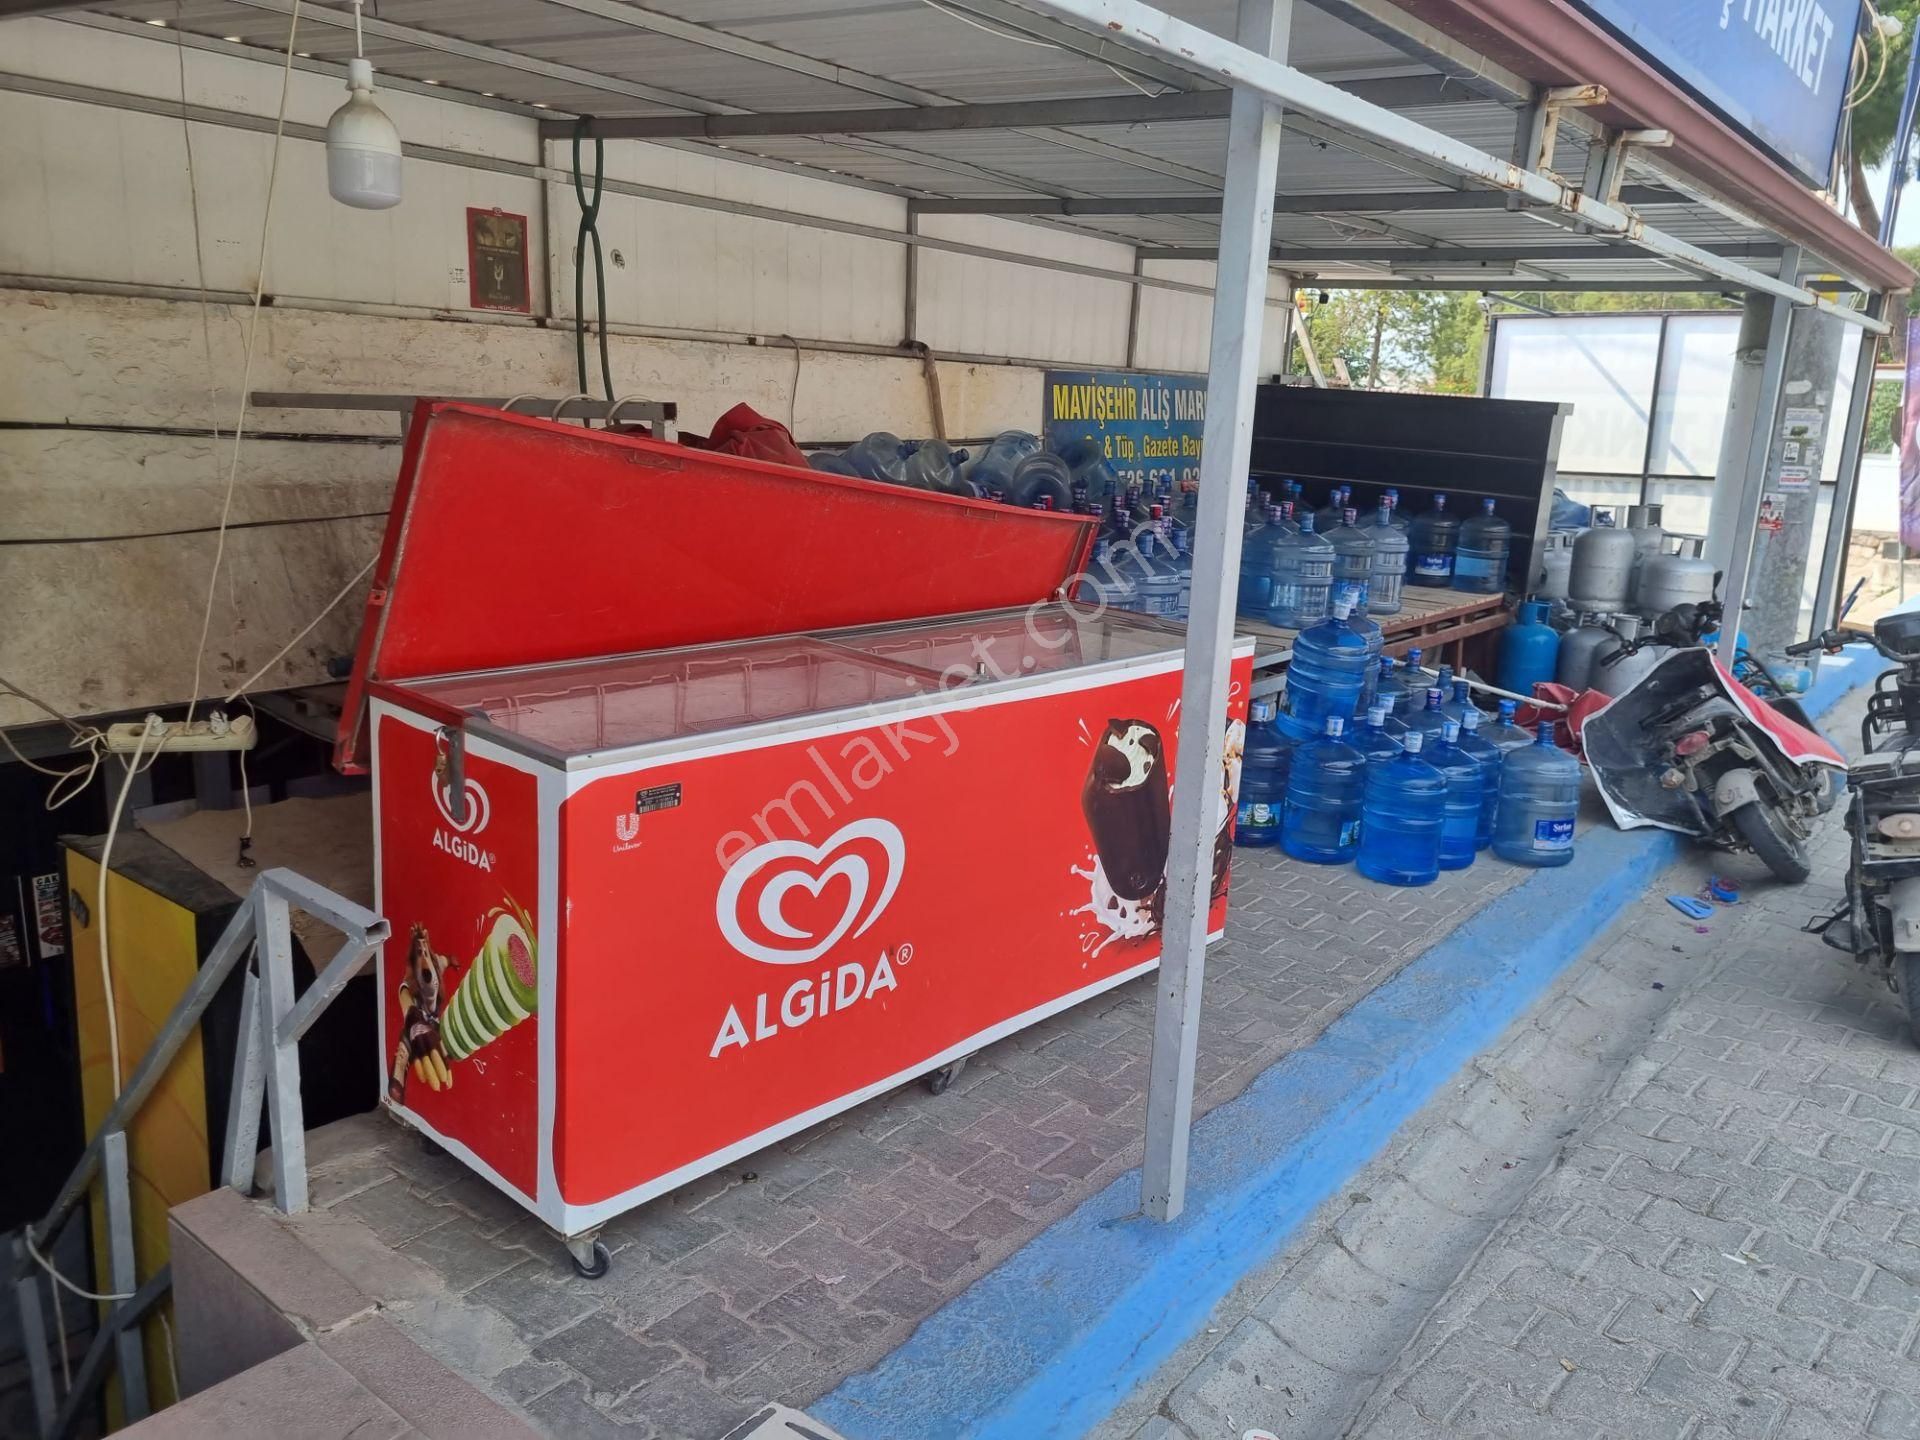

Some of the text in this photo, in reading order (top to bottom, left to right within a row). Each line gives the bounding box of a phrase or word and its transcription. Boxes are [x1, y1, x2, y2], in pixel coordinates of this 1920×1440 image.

[1053, 377, 1207, 429] MAVİŞEHİR ALİŞ MAR
[1143, 435, 1179, 458] Gazete
